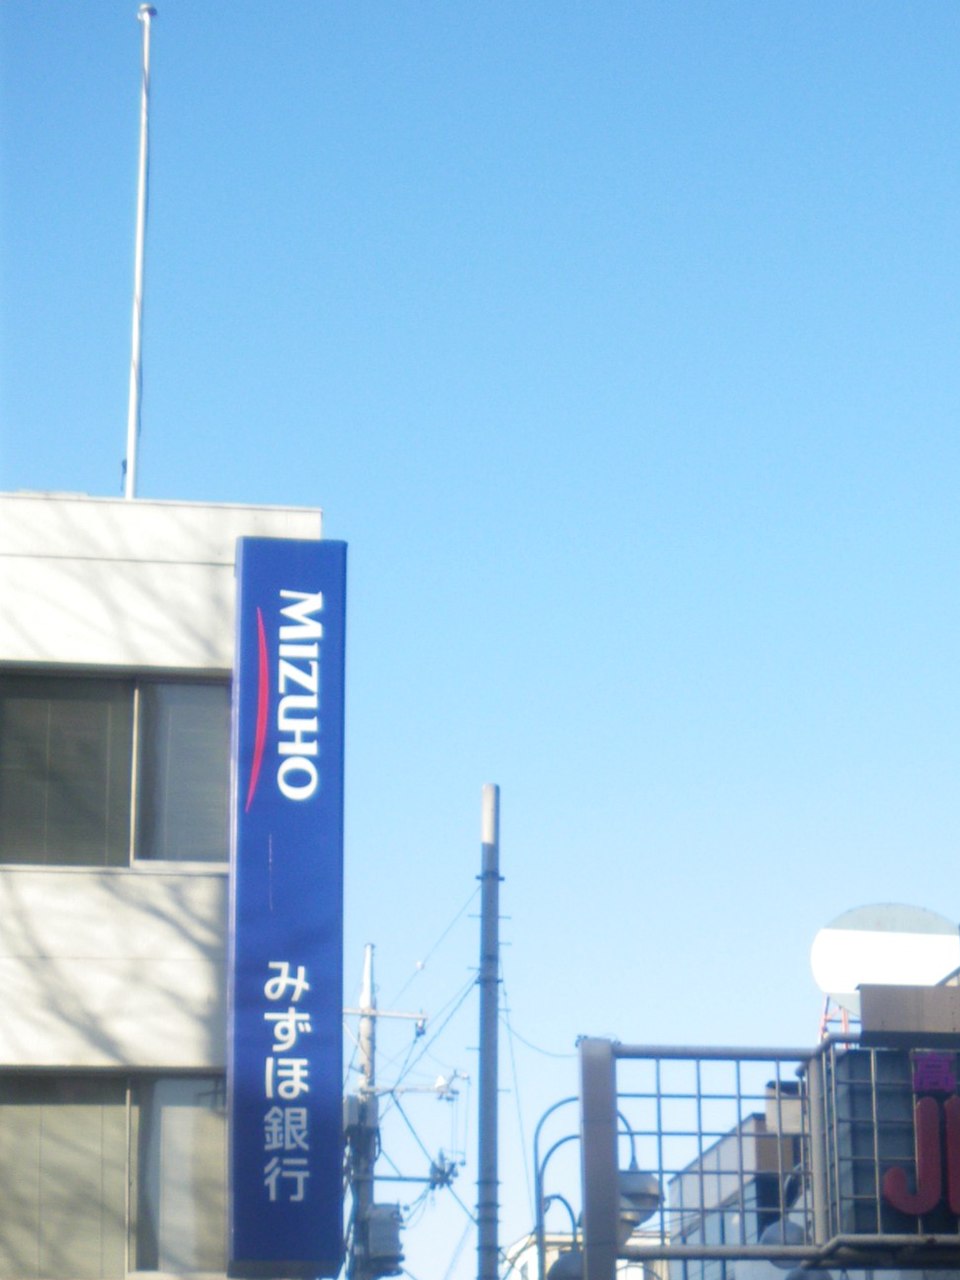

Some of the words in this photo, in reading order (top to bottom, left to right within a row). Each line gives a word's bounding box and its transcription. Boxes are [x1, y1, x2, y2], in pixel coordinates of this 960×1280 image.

[277, 588, 324, 802] MIZUHO
[263, 961, 311, 1202] みずほ銀行
